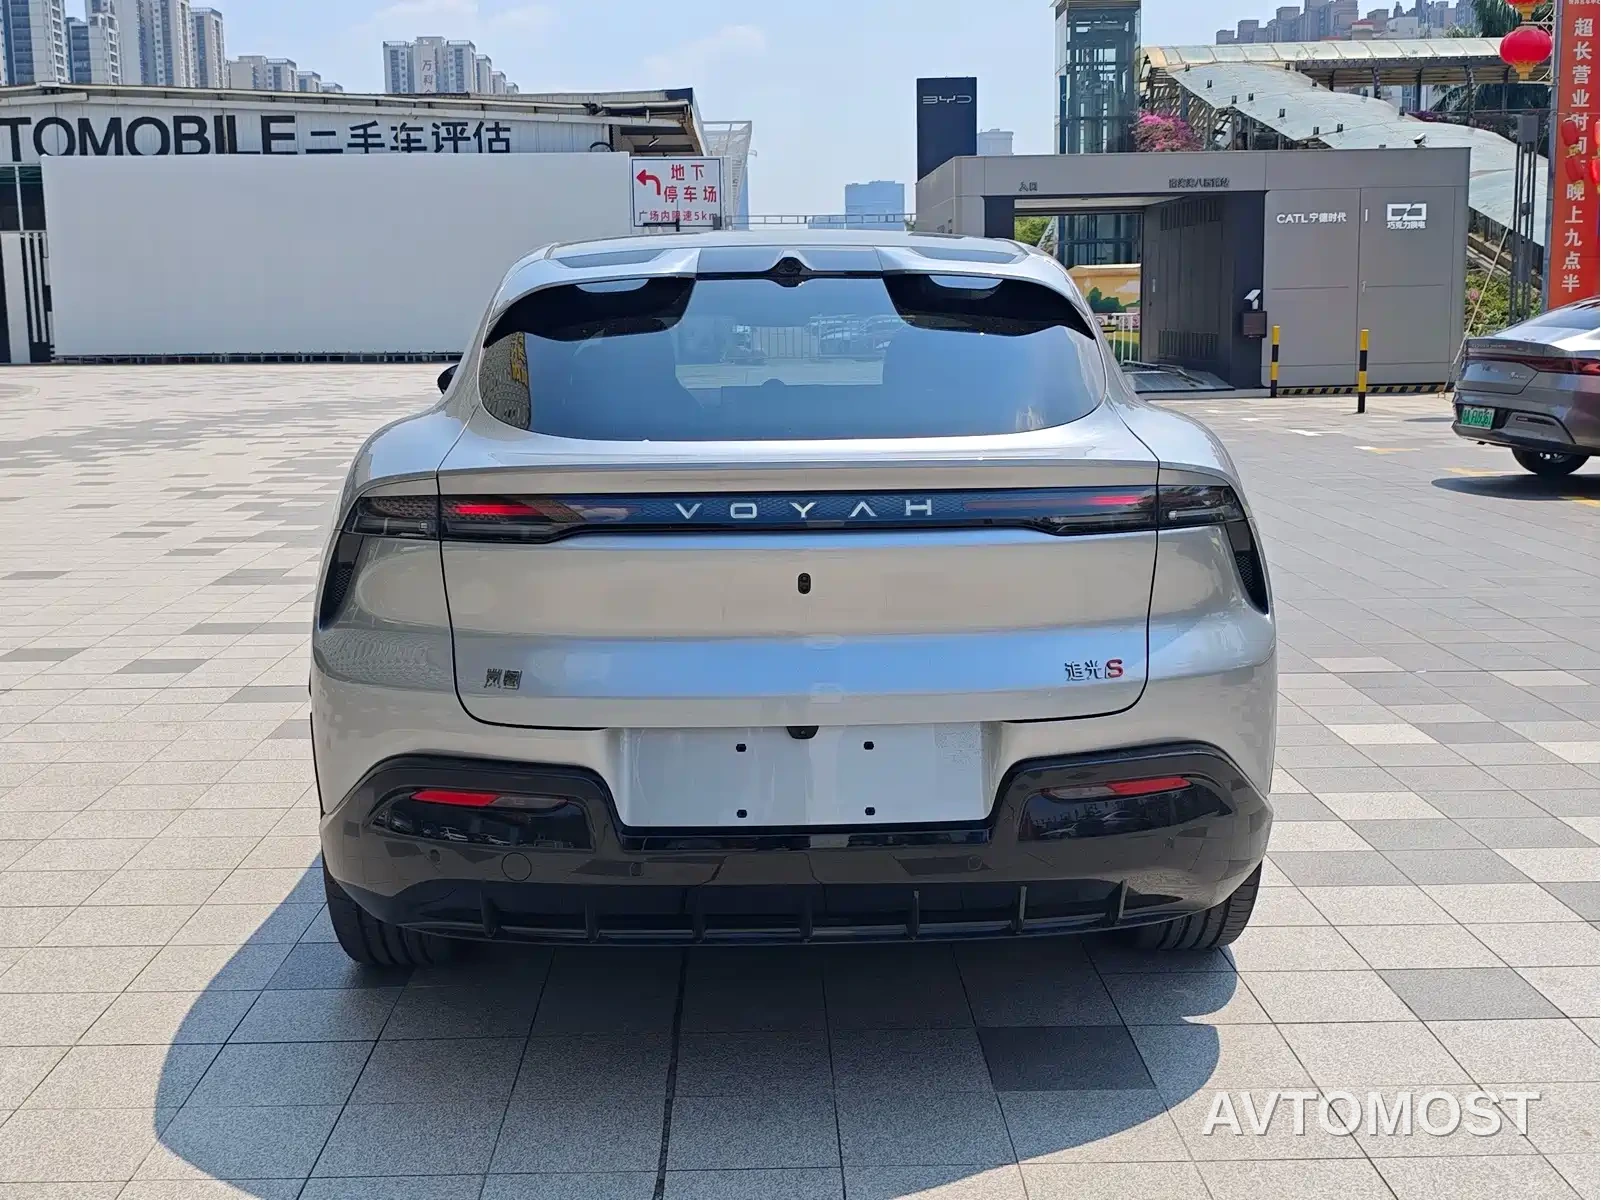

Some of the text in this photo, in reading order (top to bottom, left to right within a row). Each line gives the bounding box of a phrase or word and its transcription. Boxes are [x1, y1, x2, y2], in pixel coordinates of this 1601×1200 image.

[922, 95, 972, 104] BYD
[305, 120, 511, 154] 二手车评估
[671, 163, 705, 181] 地下
[664, 185, 717, 203] 停车场
[1276, 212, 1347, 224] CATL 宁德时代
[674, 499, 933, 520] VOYAH
